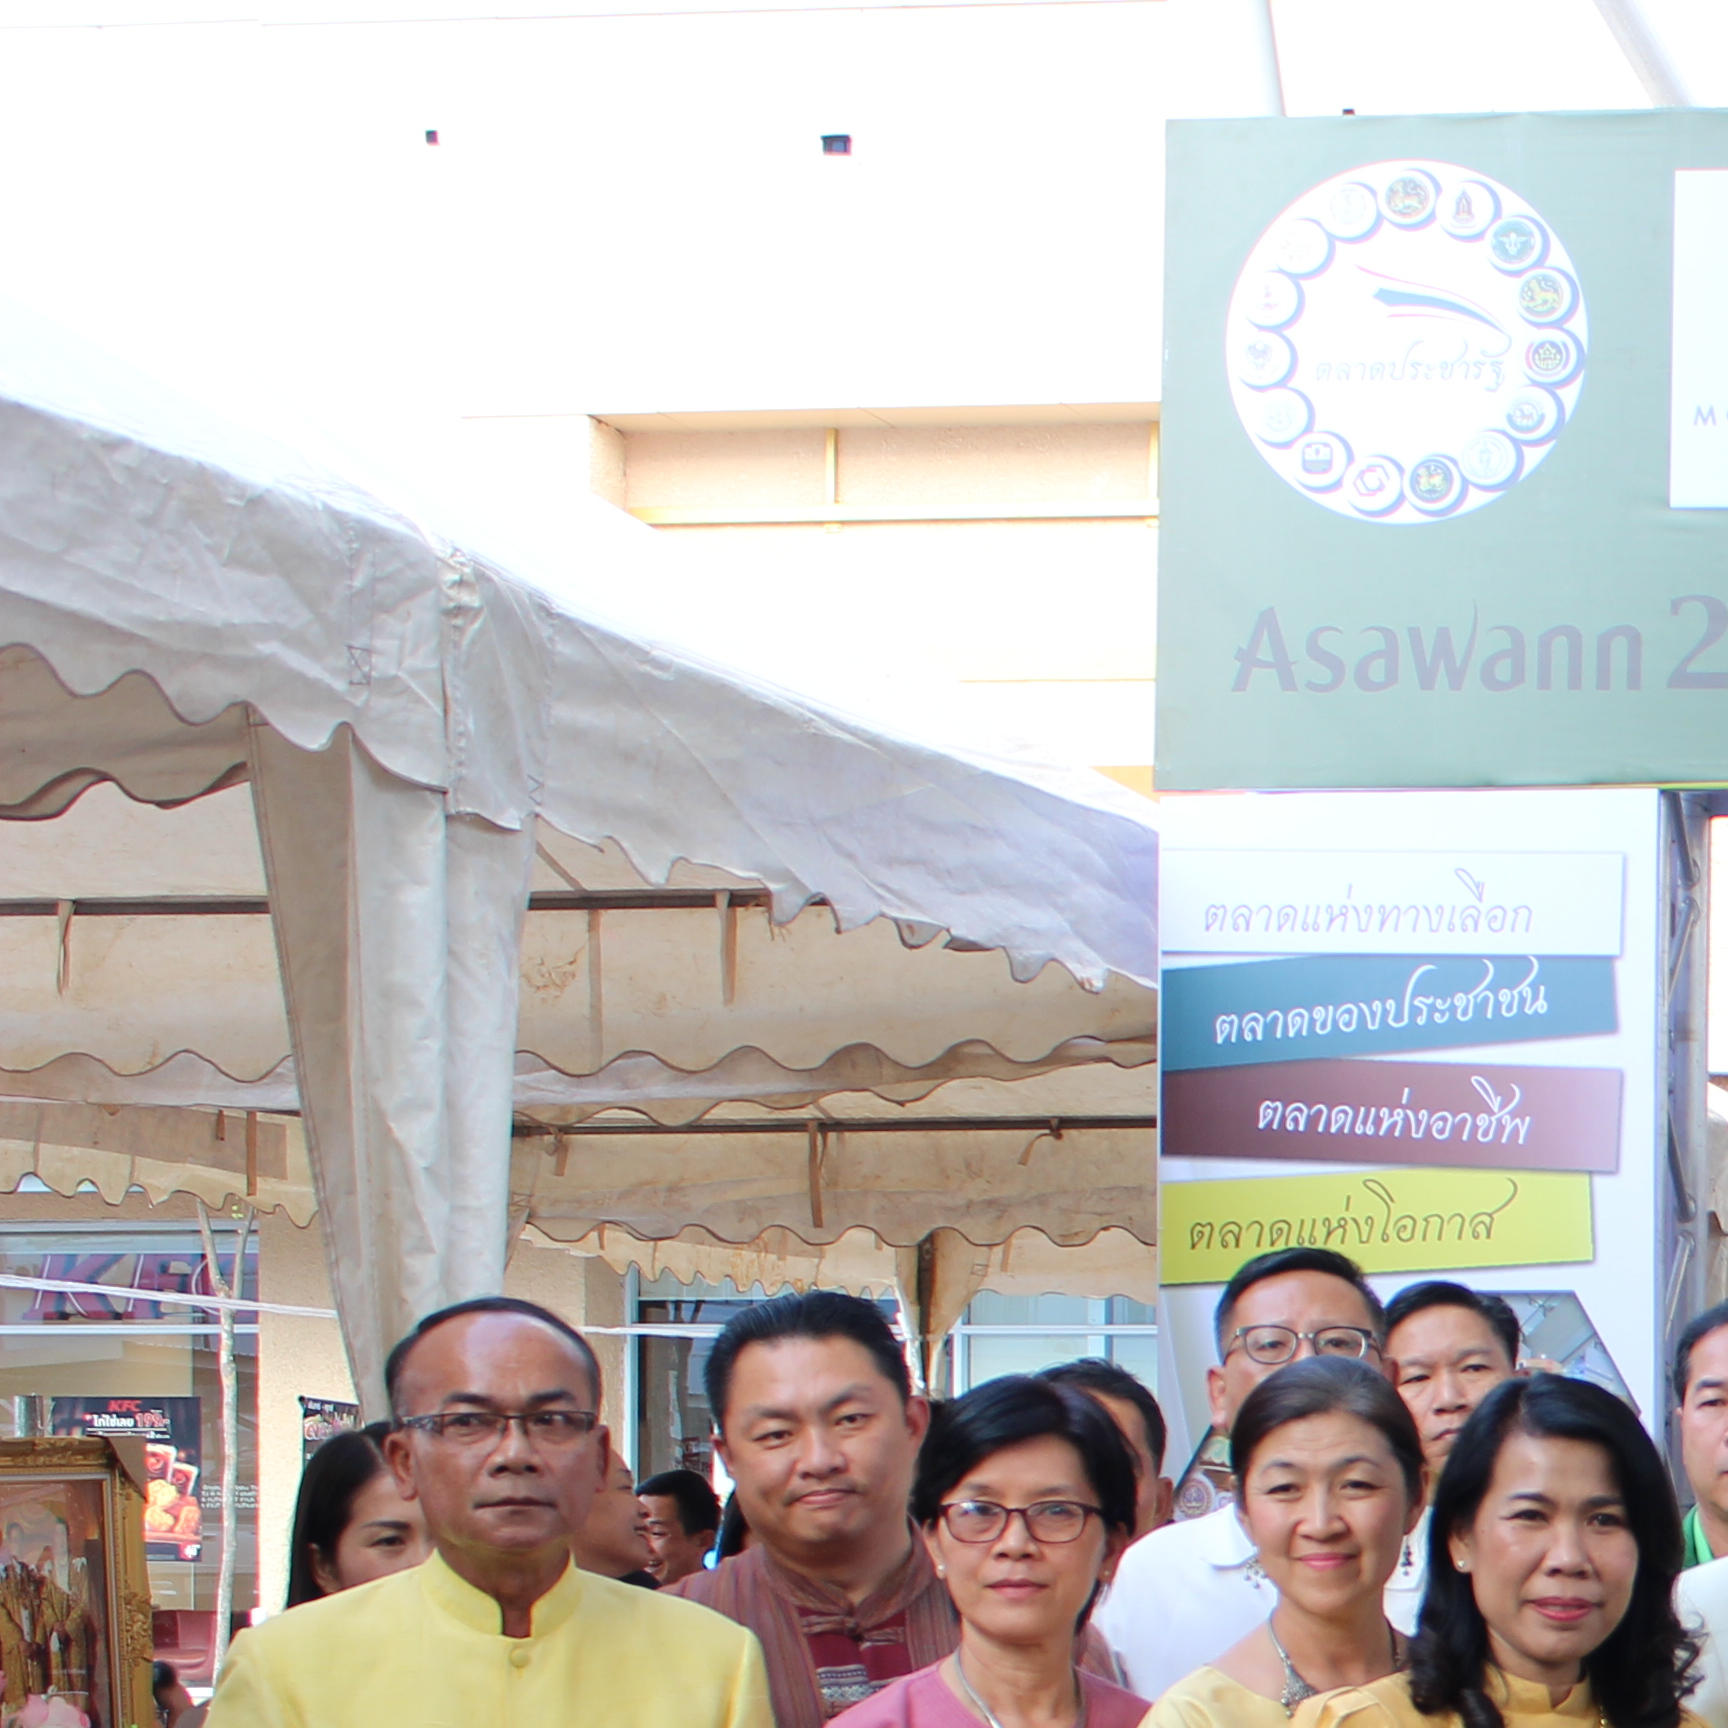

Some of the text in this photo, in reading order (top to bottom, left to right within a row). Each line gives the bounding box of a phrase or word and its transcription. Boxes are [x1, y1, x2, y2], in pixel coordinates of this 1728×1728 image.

[1230, 602, 1645, 694] Asawann
[1204, 867, 1533, 934] ตลาดแห่งทางเลือก
[1214, 956, 1548, 1045] ตลาดของประชาชน
[1256, 1076, 1531, 1144] ตลาดแห่งอาชีพ
[1188, 1177, 1518, 1250] ตลาดแห่งโอกาส
[107, 1400, 143, 1413] KFC
